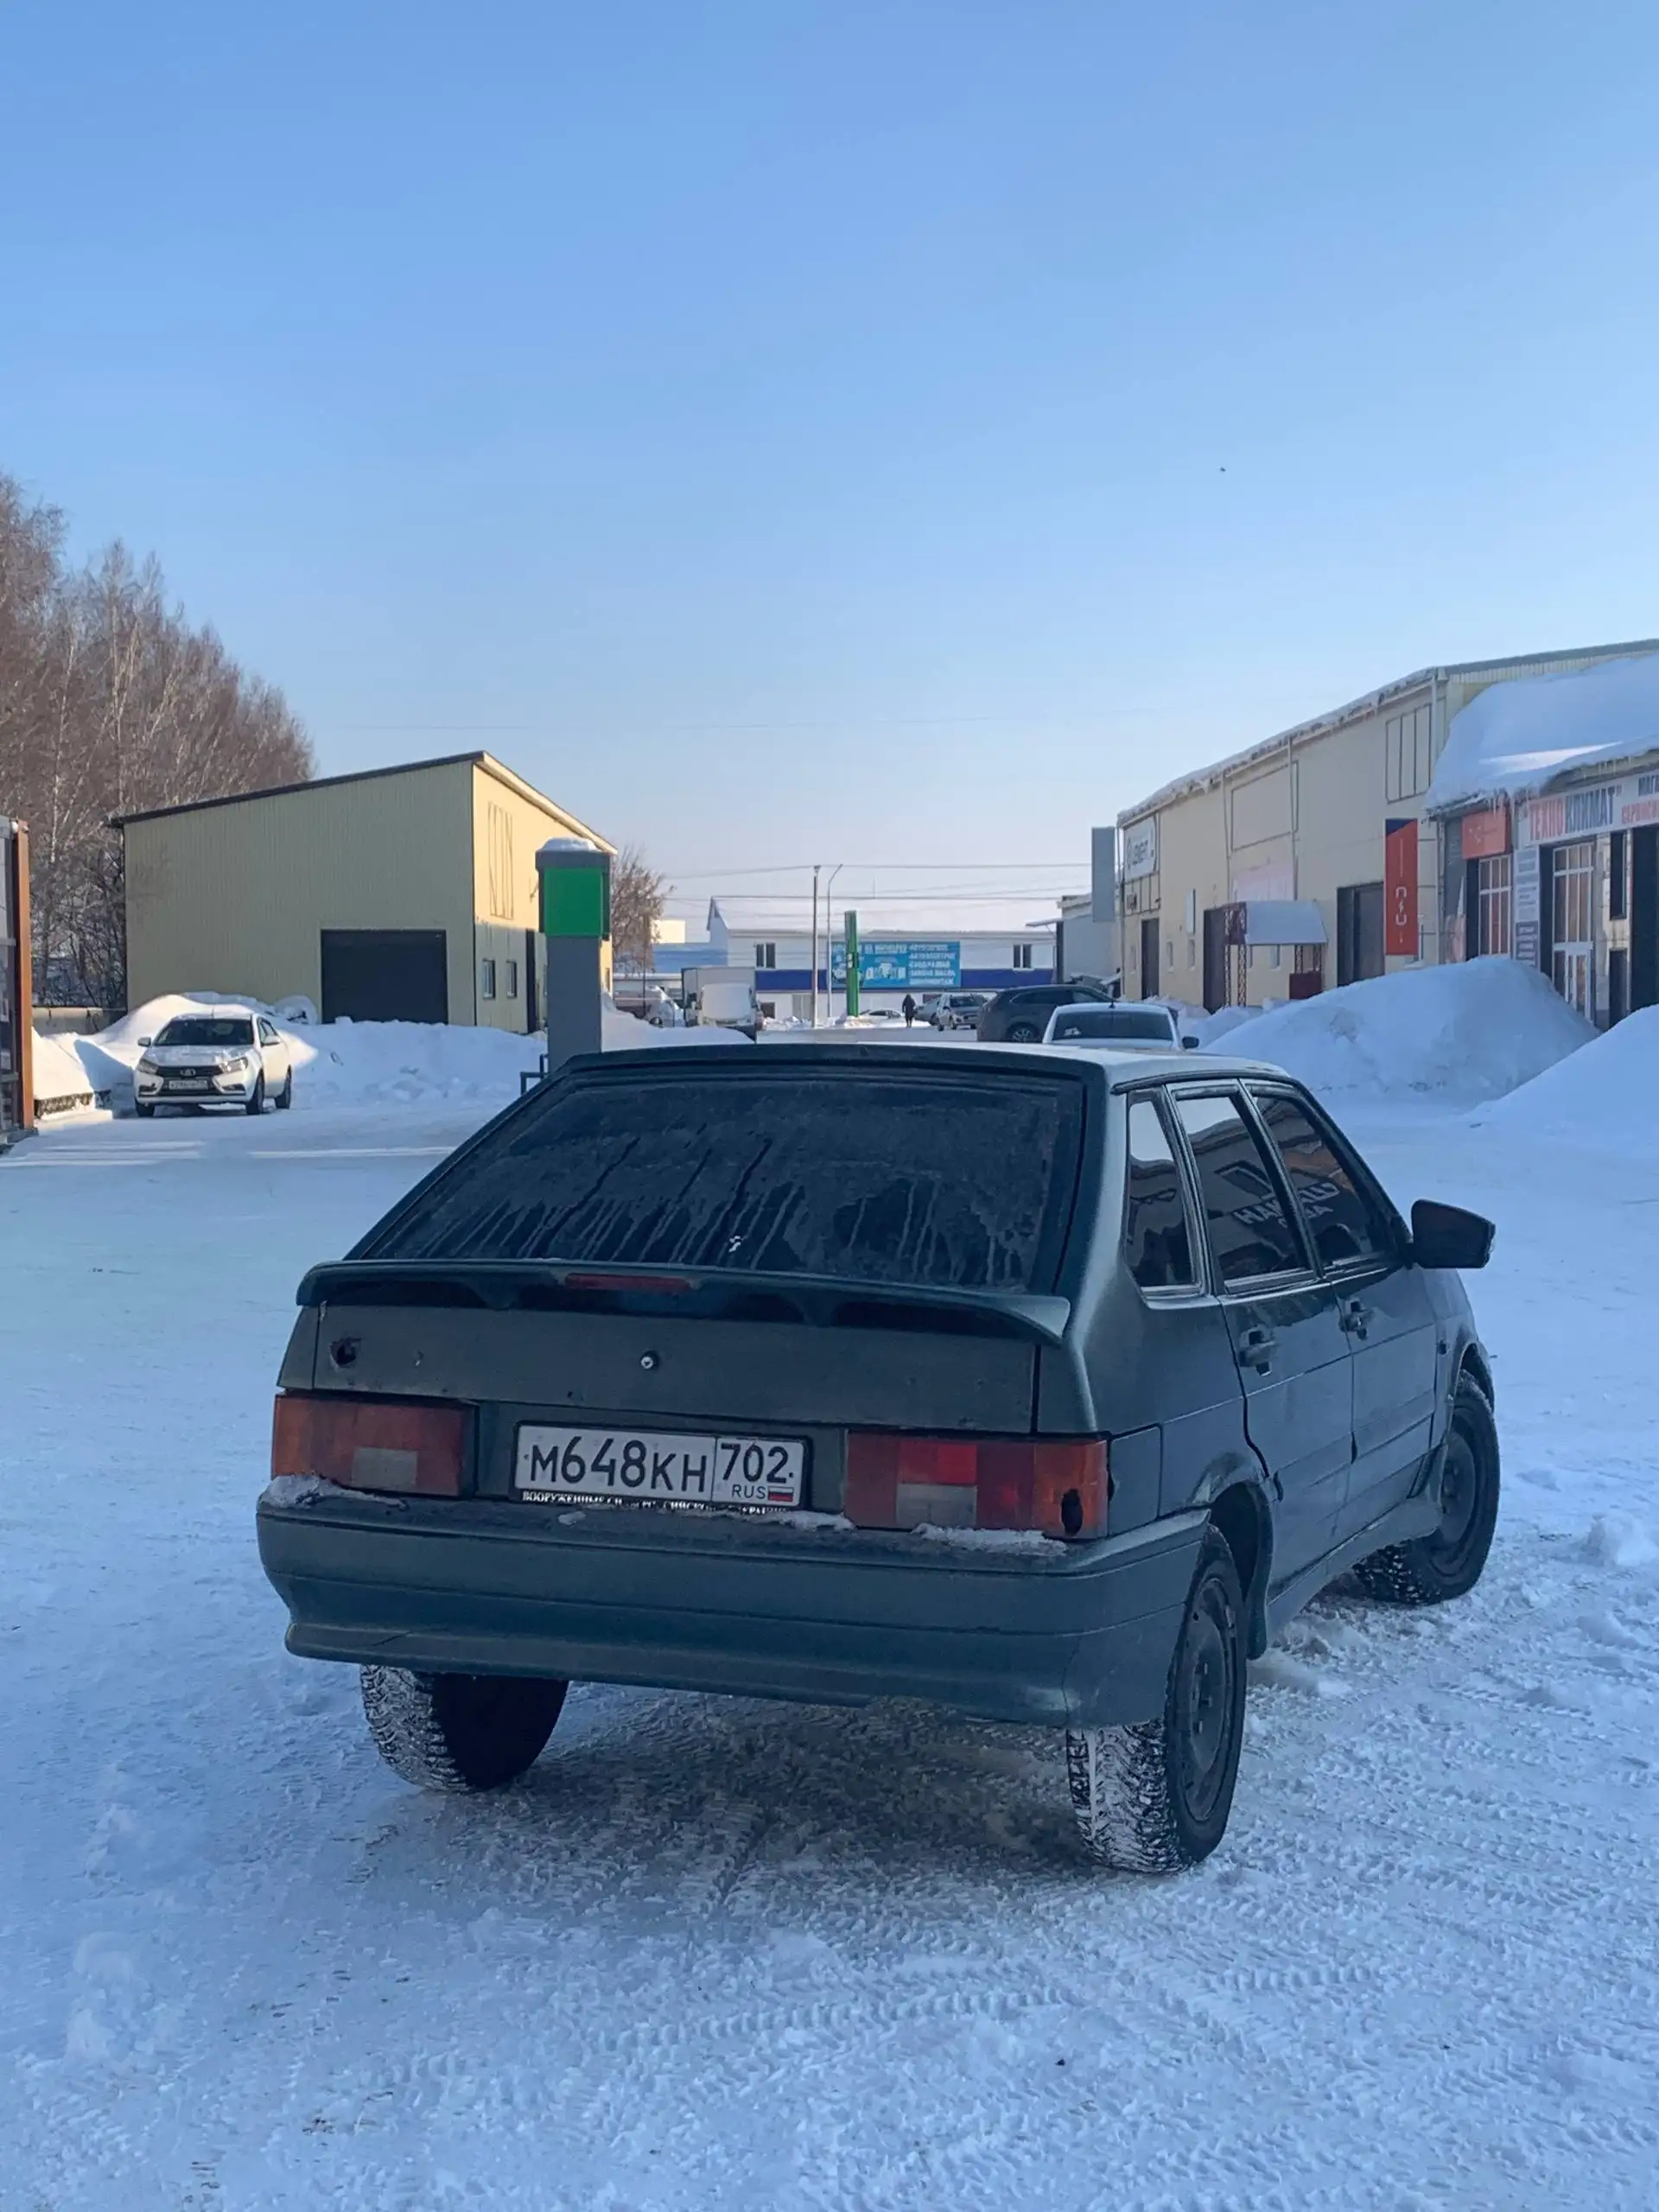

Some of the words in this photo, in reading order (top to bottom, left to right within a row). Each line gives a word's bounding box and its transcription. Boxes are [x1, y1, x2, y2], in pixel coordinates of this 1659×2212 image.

[530, 1436, 708, 1493] М648КН
[721, 1442, 789, 1484] 702
[732, 1484, 766, 1500] RUS
